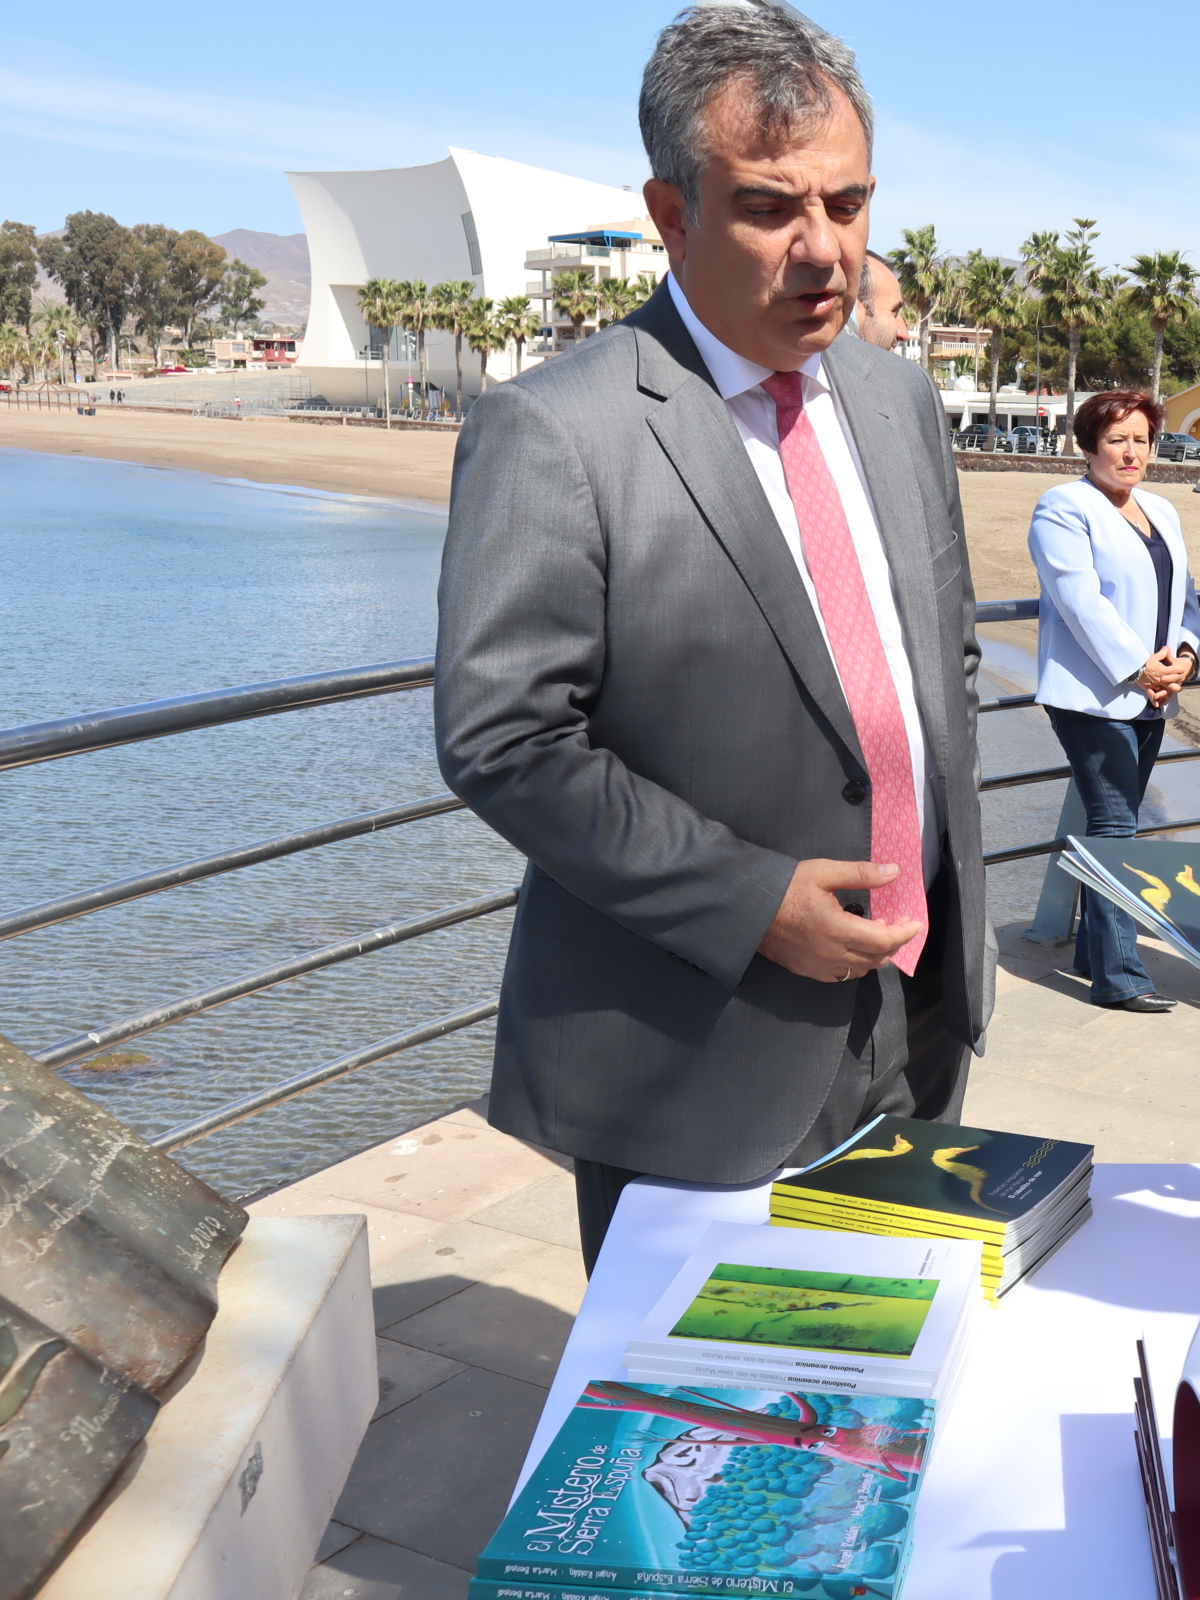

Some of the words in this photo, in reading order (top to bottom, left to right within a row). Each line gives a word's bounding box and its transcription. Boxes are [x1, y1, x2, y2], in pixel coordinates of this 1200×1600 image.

[189, 1215, 221, 1249] 2020
[702, 1352, 723, 1360] Murcia
[724, 1353, 742, 1362] Javier
[767, 1358, 794, 1367] Praderas
[795, 1361, 828, 1370] oceanica
[695, 1366, 716, 1375] Murcia
[716, 1368, 734, 1377] Javier
[829, 1364, 865, 1374] Posidonia
[760, 1373, 786, 1383] Praderas
[787, 1376, 821, 1385] oceanica
[821, 1379, 857, 1389] Posidonia
[589, 1444, 608, 1455] de
[586, 1448, 643, 1502] Espuña
[523, 1456, 605, 1554] Misterio
[576, 1506, 612, 1557] Sierra
[527, 1540, 553, 1552] El
[504, 1565, 529, 1576] Benedí
[531, 1566, 557, 1577] Marta
[569, 1568, 593, 1581] Roldán
[594, 1570, 617, 1583] Ángel
[635, 1572, 674, 1587] Espuña
[678, 1576, 709, 1588] Sierra
[711, 1577, 722, 1587] de
[725, 1576, 779, 1593] Misterio
[783, 1580, 794, 1594] El
